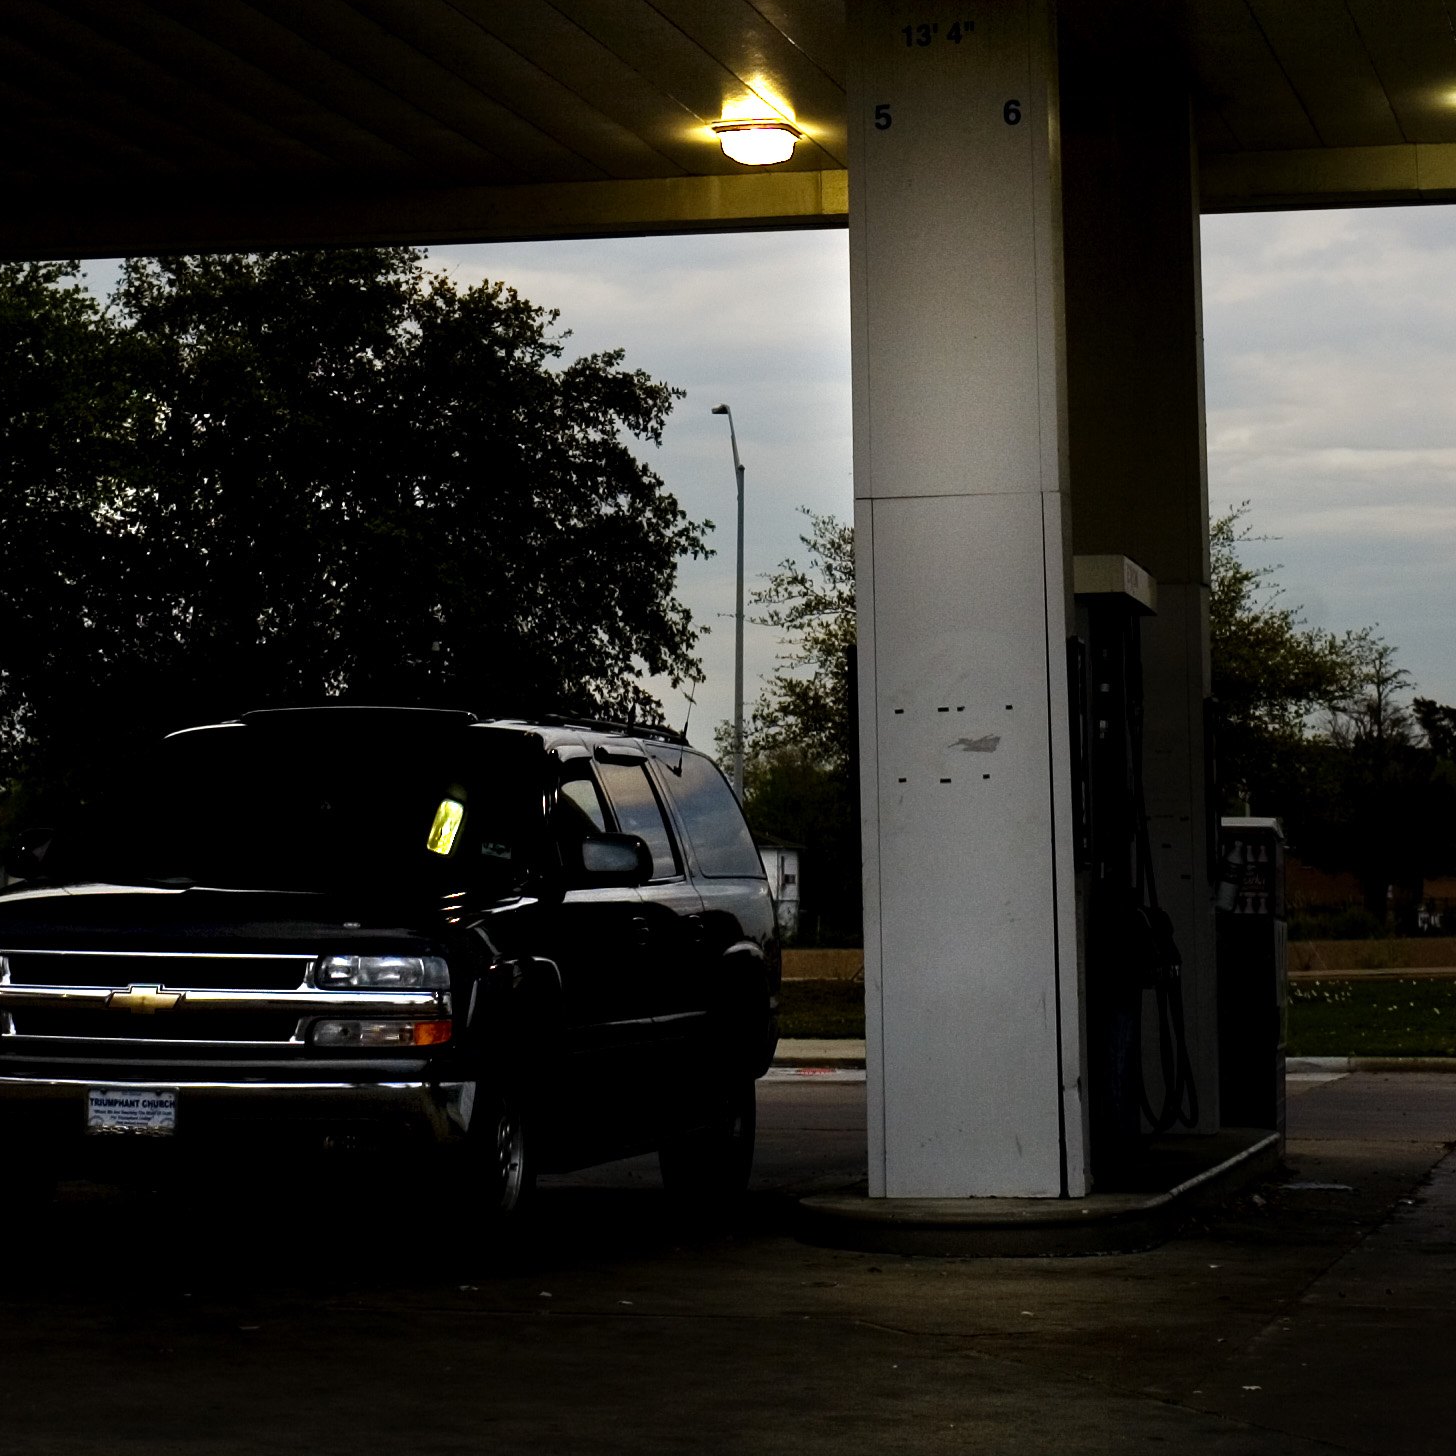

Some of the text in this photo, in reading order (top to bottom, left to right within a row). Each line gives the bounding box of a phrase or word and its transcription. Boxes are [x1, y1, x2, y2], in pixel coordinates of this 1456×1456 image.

[875, 104, 892, 130] 5
[1003, 100, 1022, 125] 6
[89, 1098, 176, 1109] TRIUMPHANT CHURCH
